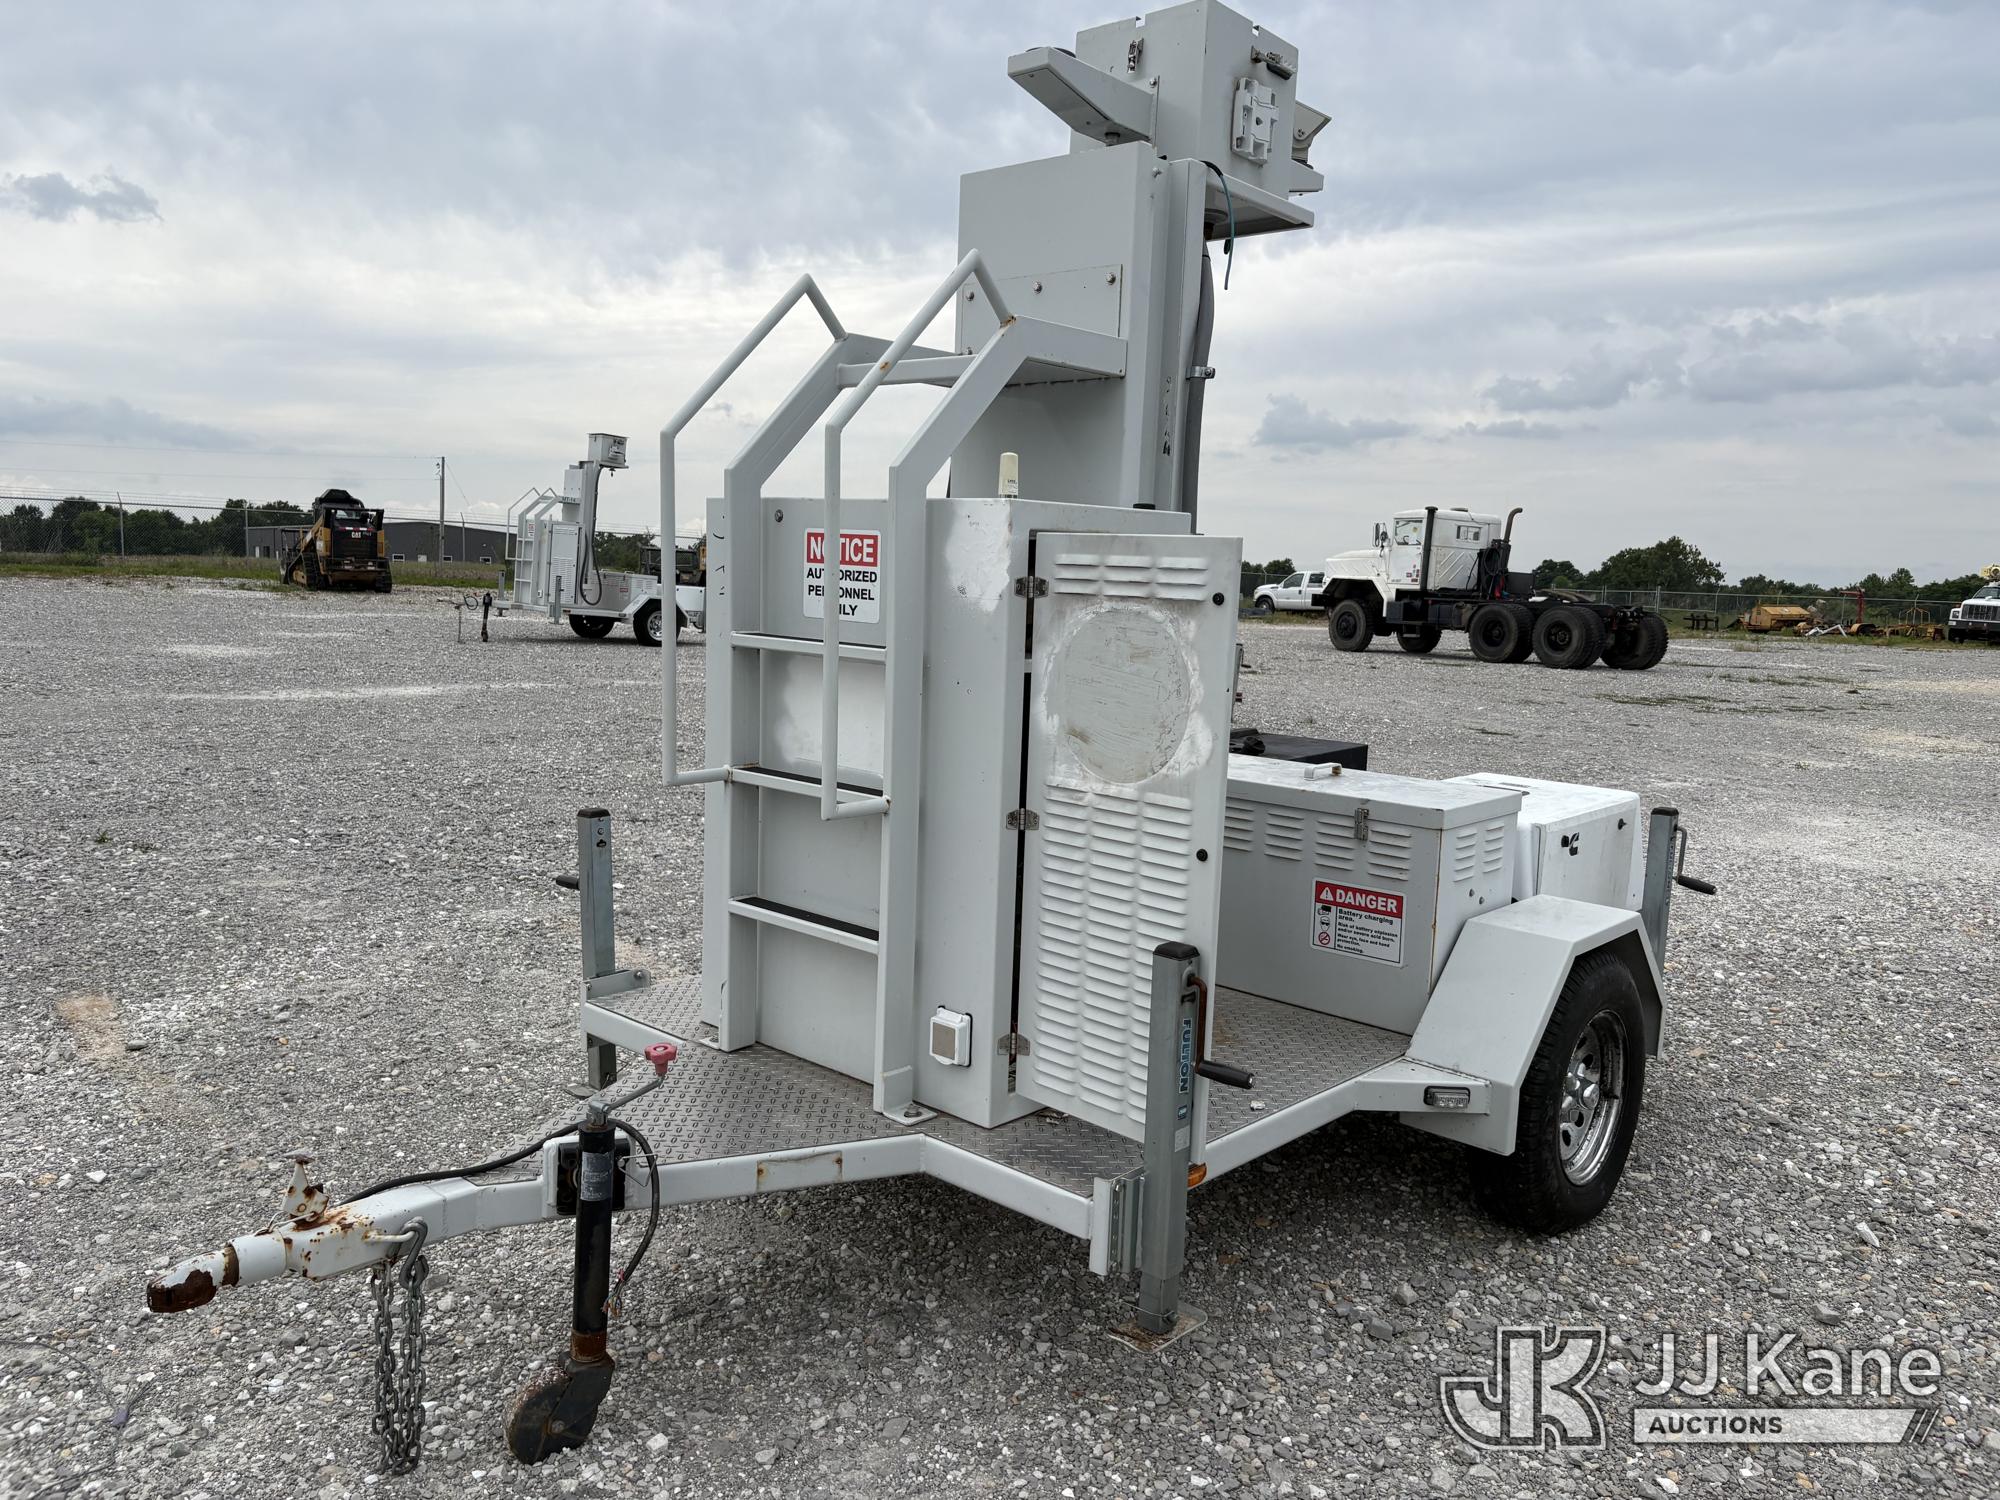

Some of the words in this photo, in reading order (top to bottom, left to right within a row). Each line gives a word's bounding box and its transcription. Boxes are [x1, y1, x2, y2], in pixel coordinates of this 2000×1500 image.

[810, 536, 874, 563] NTICE
[807, 567, 877, 583] AUORIZED
[808, 584, 875, 601] PEONNEL
[1336, 889, 1397, 913] DANGER
[1338, 908, 1363, 919] Battery
[1364, 914, 1394, 925] charging
[1355, 925, 1373, 933] battery
[1179, 1018, 1192, 1093] FULTON
